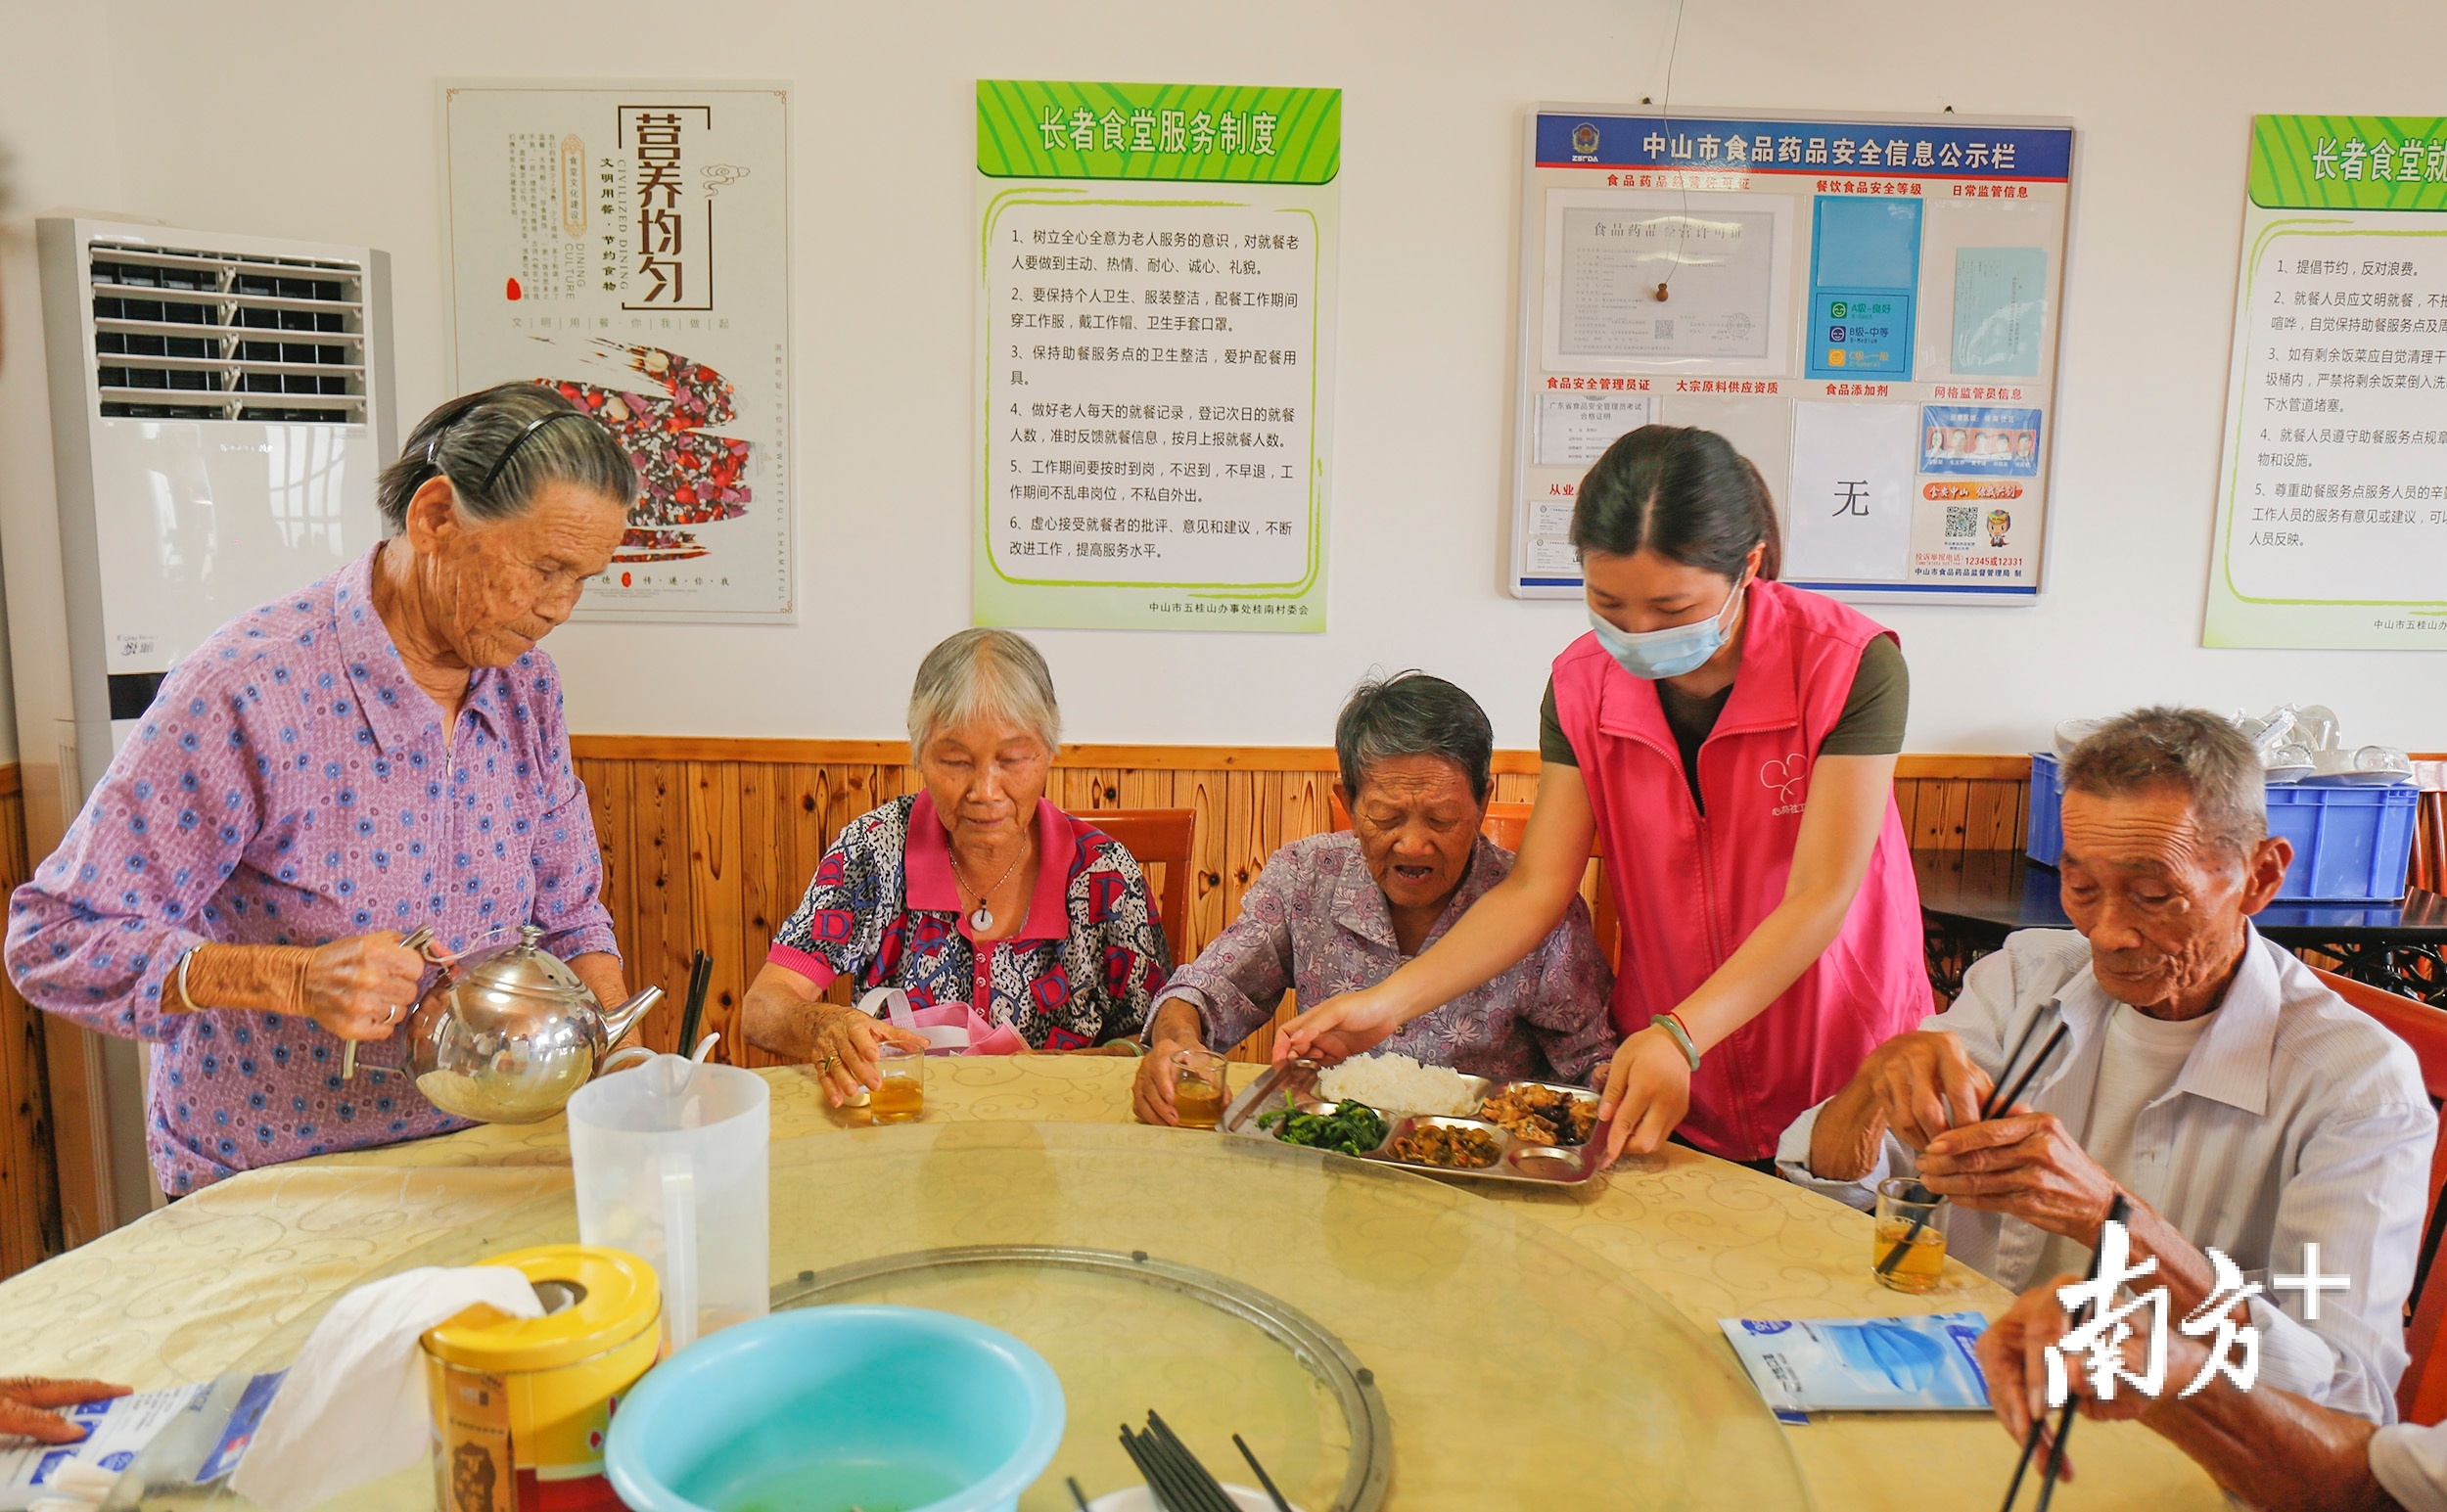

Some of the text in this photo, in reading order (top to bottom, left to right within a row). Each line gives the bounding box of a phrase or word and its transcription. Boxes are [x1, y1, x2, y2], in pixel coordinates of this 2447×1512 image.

[1038, 106, 1278, 157] 长者食堂服务制度
[1642, 131, 2016, 170] 中山市食品药品安全信息公示栏
[570, 157, 578, 219] 食堂文化建设
[1816, 179, 1922, 196] 餐饮食品安全等级
[1952, 184, 2029, 199] 日常监管信息
[636, 114, 683, 304] 营养均匀
[618, 159, 628, 291] CIVILIZED DINING
[1011, 229, 1299, 251] 1、树立全心全意为老人服务的意识，对就餐老
[565, 243, 576, 299] CULTURE
[576, 243, 586, 288] DINING
[1011, 254, 1262, 276] 人要做到主动、热情、耐心、诚心、礼貌。
[2277, 259, 2420, 278] 1、提倡节约，反对浪费。
[1011, 287, 1299, 308] 2、要保持个人卫生、服装整洁，配餐工作期间
[1010, 312, 1234, 333] 穿工作服，戴工作帽、卫生手套口罩。
[1010, 344, 1297, 366] 3、保持助餐服务点的卫生整洁，爱护配餐用
[1010, 370, 1029, 386] 具。
[1547, 377, 1651, 391] 食品安全管理员证
[1676, 380, 1779, 394] 大宗原料供应资质
[2265, 372, 2447, 389] 圾桶内，严禁将剩余饭菜倒入洗
[1825, 383, 1889, 397] 食品添加剂
[1934, 386, 2023, 401] 网格监管员信息
[1009, 402, 1295, 423] 4、做好老人每天的就餐记录，登记次日的就餐
[1549, 401, 1642, 411] 广东省食品安全管理员考试
[2263, 397, 2344, 413] 下水管道堵塞。
[1581, 412, 1611, 421] 合格证明
[1009, 428, 1285, 448] 人数，准时反馈就餐信息，按月上报就餐人数。
[1009, 459, 1293, 479] 5、工作期间要按时到岗，不迟到，不早退，工
[2257, 452, 2313, 468] 物和设施。
[1009, 484, 1203, 503] 作期间不乱串岗位，不私自外出。
[1548, 483, 1582, 496] 从业
[1831, 480, 1870, 517] 无
[1009, 516, 1293, 536] 6、虚心接受就餐者的批评、意见和建议，不断
[2248, 531, 2305, 547] 人员反映。
[1009, 541, 1162, 559] 改进工作，提高服务水平。
[1965, 557, 2023, 567] 12345或12331
[1915, 568, 2023, 578] 中山市食品药品监督管理局 制
[1149, 602, 1310, 617] 中山市五桂山办事处桂南村委会
